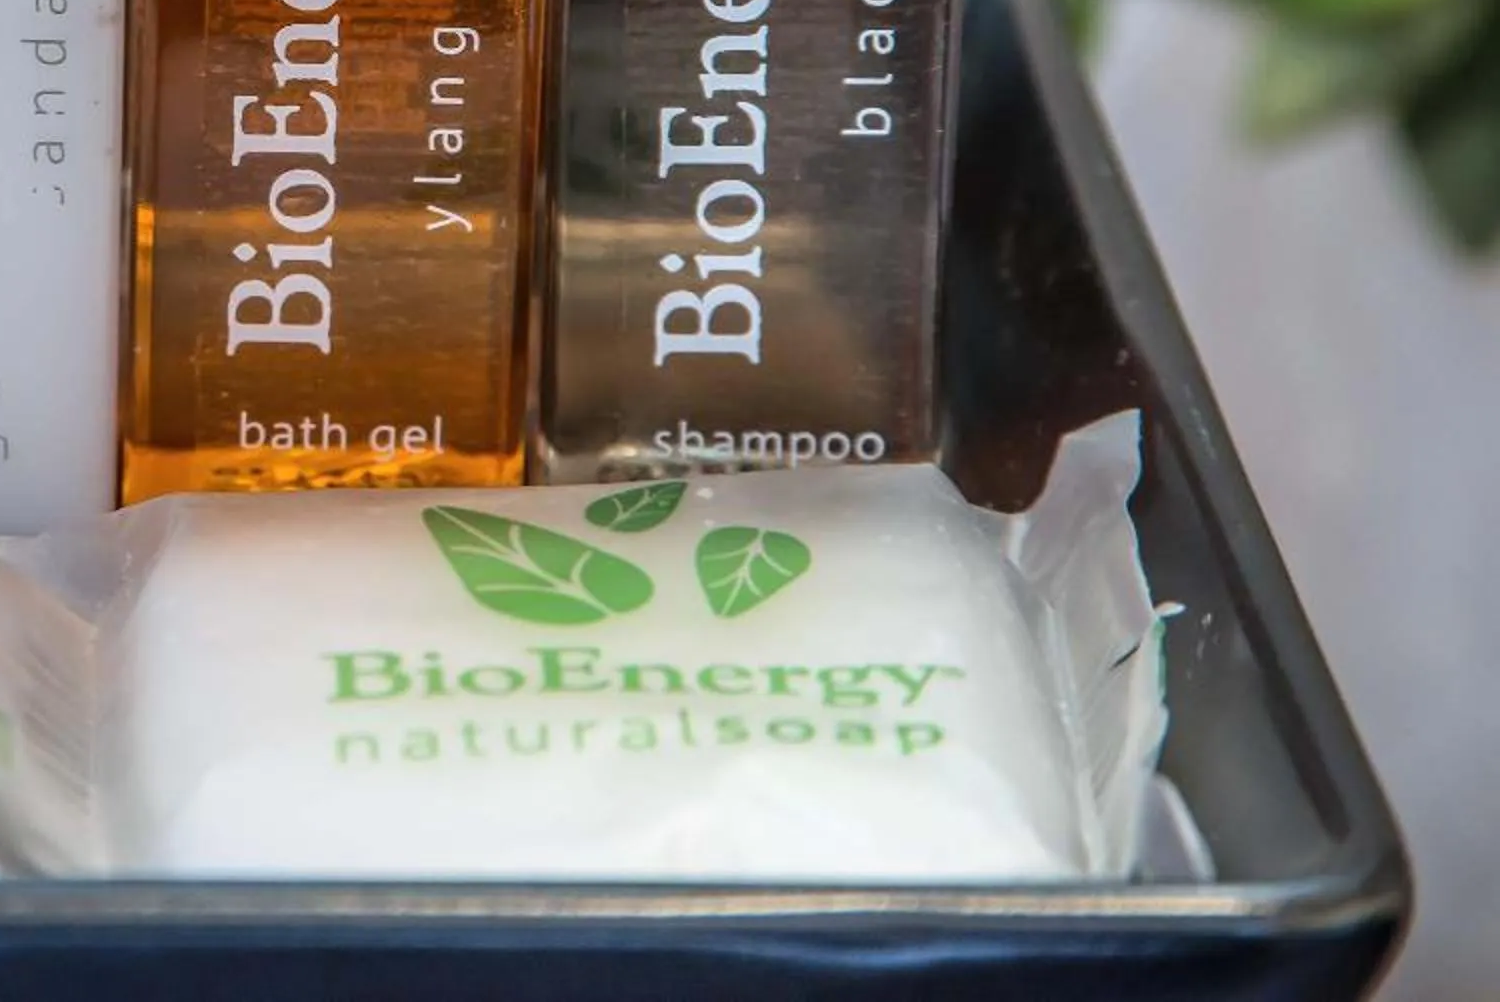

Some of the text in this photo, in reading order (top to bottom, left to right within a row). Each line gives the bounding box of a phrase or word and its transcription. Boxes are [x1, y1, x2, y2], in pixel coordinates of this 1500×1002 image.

[414, 26, 481, 234] ylang
[239, 411, 445, 462] bath gel
[653, 420, 886, 469] shampoo
